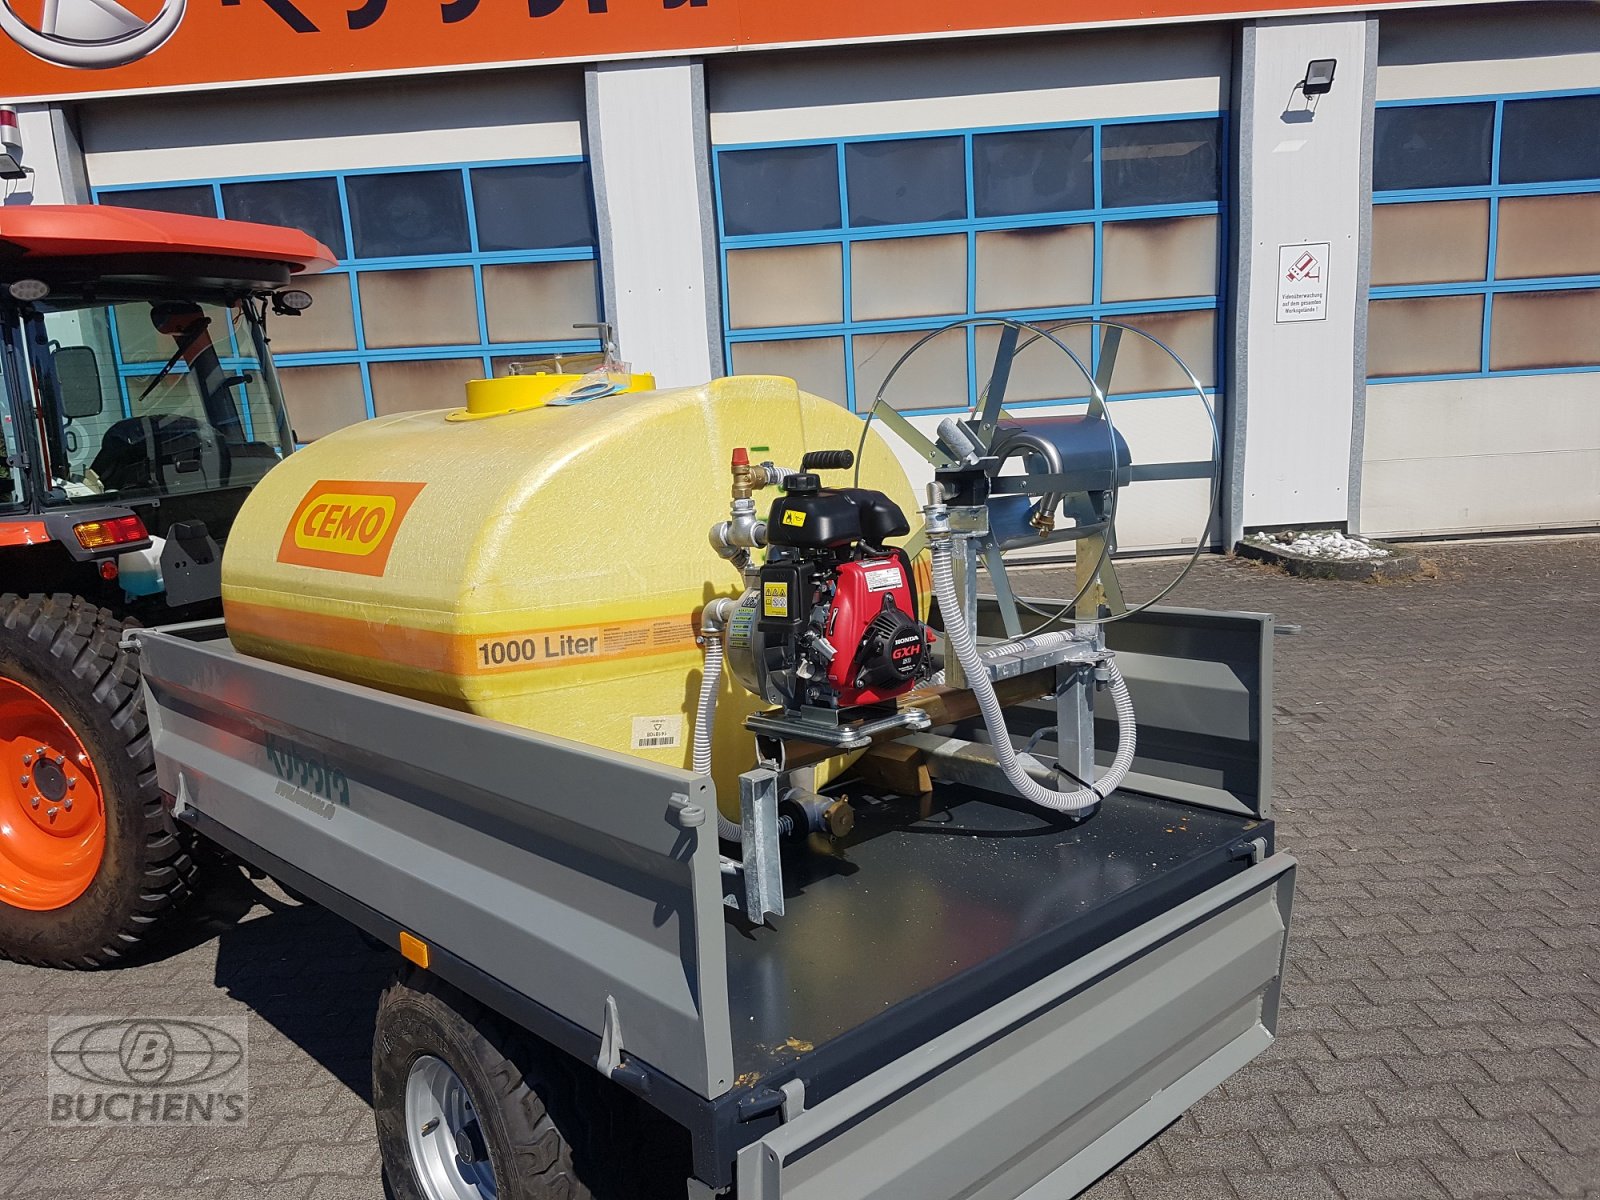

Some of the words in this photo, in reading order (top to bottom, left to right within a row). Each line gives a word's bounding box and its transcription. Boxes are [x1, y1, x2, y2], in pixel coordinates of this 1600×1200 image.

[303, 503, 386, 544] CEMO
[478, 638, 536, 665] 1000
[544, 634, 599, 658] Liter
[892, 643, 920, 659] GXH
[894, 635, 919, 646] HONDA
